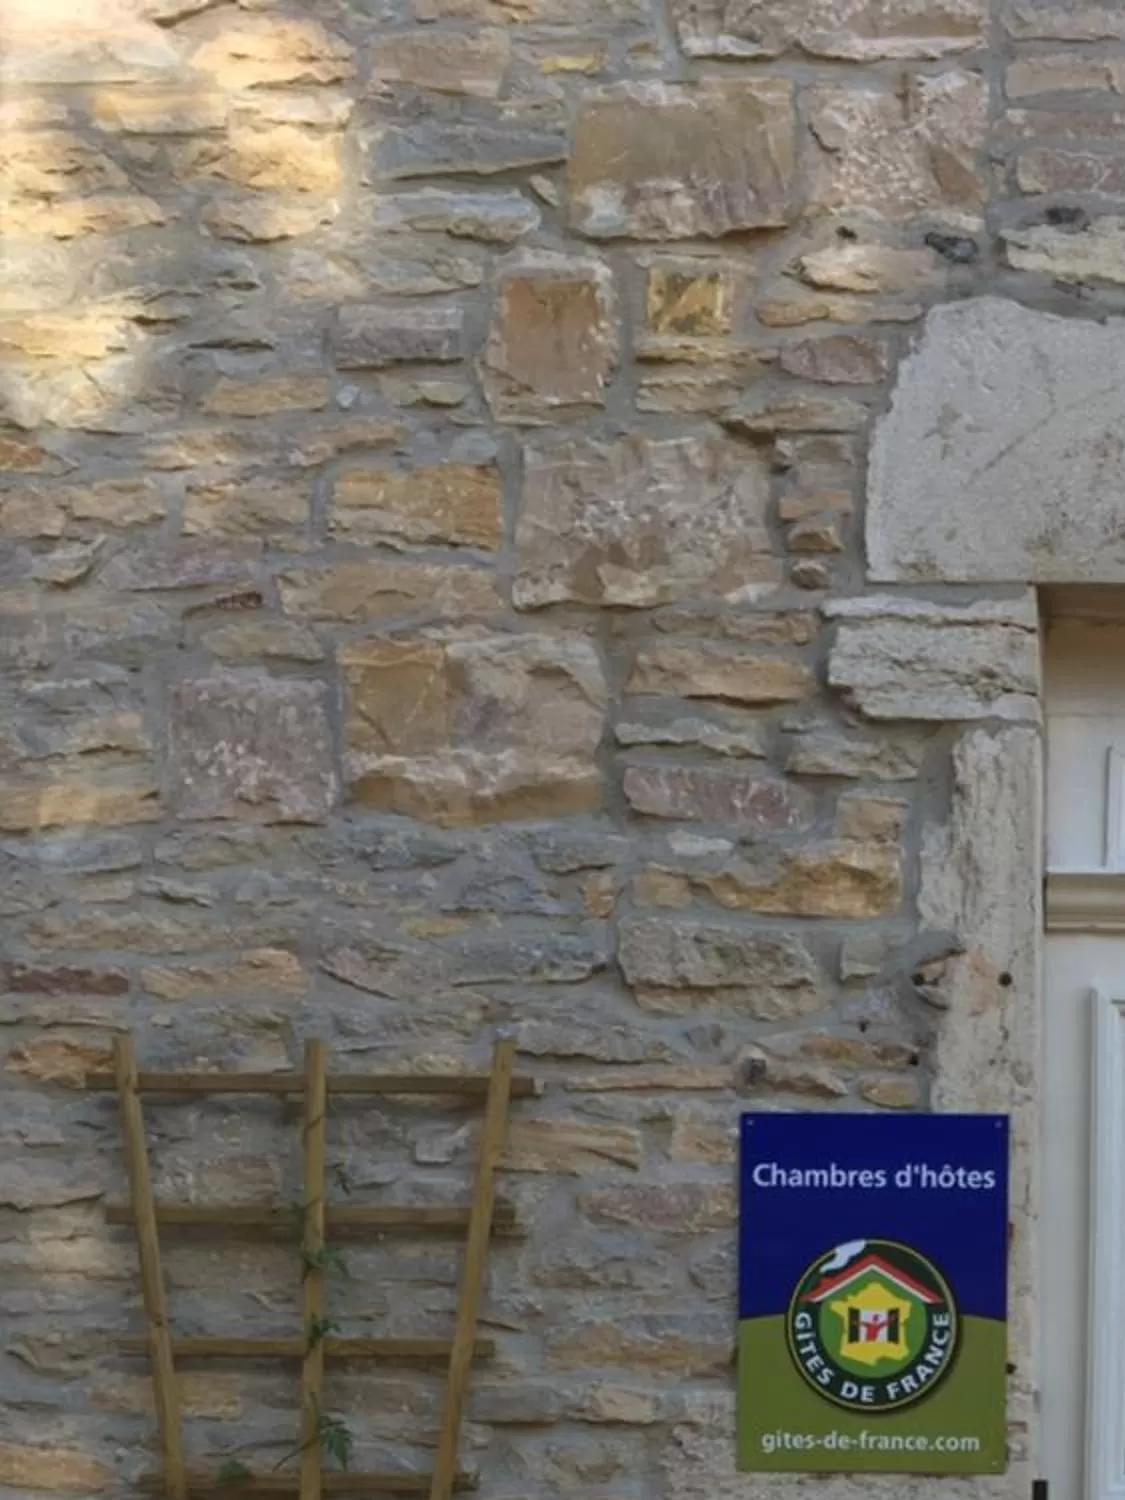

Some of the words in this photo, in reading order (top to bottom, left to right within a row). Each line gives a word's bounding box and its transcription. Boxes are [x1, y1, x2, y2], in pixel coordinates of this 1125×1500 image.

[752, 1163, 886, 1188] Chambres
[895, 1164, 996, 1189] d'hôtes
[840, 1381, 875, 1403] DE
[886, 1312, 949, 1400] FRANCE
[761, 1430, 980, 1453] gites-de-france.com
